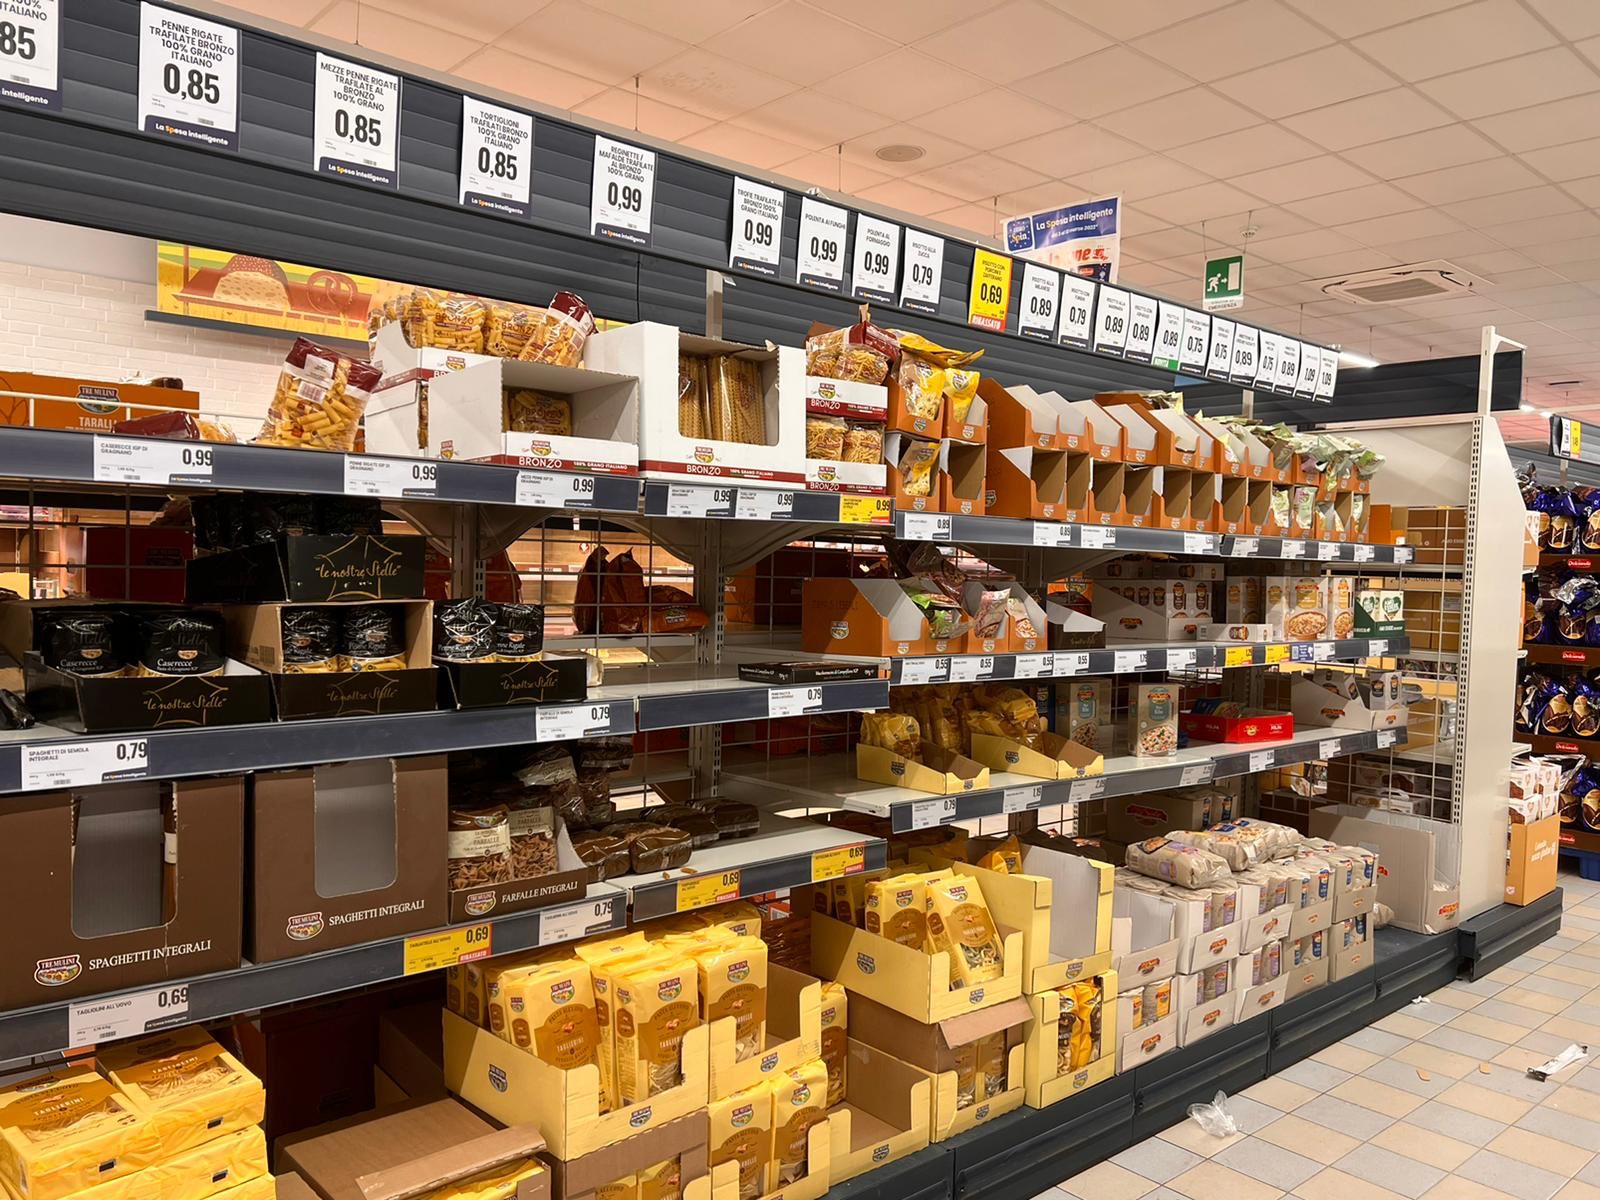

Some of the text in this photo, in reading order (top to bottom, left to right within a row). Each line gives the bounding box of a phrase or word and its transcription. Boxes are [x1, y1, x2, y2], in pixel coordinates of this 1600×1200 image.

[161, 19, 223, 43] PENNE RIGATE
[149, 26, 235, 56] TRAFILATE BRONZO
[161, 38, 223, 62] 100% GRANO
[171, 51, 213, 68] ITALIANO
[163, 63, 220, 104] 0,85
[320, 62, 397, 91] MEZZE PENNE RIGATE
[335, 74, 384, 95] TRAFILATE AL
[2, 88, 49, 104] intelligente
[333, 90, 384, 112] 100% GRANO
[343, 85, 375, 101] BRONZO
[470, 115, 528, 140] TRAFILATI BRONZO
[479, 110, 520, 128] TORTIGLIONI
[155, 123, 229, 145] La Spesa intelligente
[335, 109, 382, 147] 0,85
[477, 126, 520, 145] 100% GRANO
[484, 136, 513, 151] ITALIANO
[599, 150, 653, 171] MAFALDE TRAFILATE
[610, 145, 640, 161] REGINETTE
[478, 147, 517, 180] 0,85
[611, 160, 642, 175] AL BRONZO
[607, 166, 645, 183] 100% GRANO
[607, 181, 642, 213] 0,99
[743, 198, 762, 208] BRONZO
[740, 204, 779, 221] GRANO ITALIANO
[1036, 222, 1045, 231] La
[1045, 216, 1068, 230] Spesa
[1068, 207, 1114, 223] intelligente
[744, 219, 773, 246] 0,99
[810, 236, 838, 263] 0,99
[864, 250, 889, 275] 0,99
[912, 263, 933, 286] 0,79
[980, 283, 1003, 305] 0,69
[1030, 296, 1052, 317] 0,89
[435, 312, 474, 325] BRONZO
[1069, 306, 1087, 326] 0,79
[1104, 315, 1124, 334] 0,89
[1132, 322, 1150, 342] 0,89
[1162, 329, 1179, 347] 0,89
[1187, 335, 1203, 354] 0,75
[1214, 342, 1228, 360] 0,75
[1234, 349, 1253, 366] 0,89
[1281, 360, 1296, 377] 0,89
[811, 399, 841, 410] BRONZO
[182, 448, 214, 467] 0,99
[518, 456, 562, 469] BRONZO
[412, 464, 437, 481] 0,99
[686, 464, 721, 475] BRONZO
[573, 478, 594, 493] 0,99
[810, 481, 840, 492] BRONZO
[713, 489, 731, 502] 0,99
[777, 493, 793, 506] 0,99
[876, 499, 890, 511] 0,99
[937, 518, 950, 529] 0,89
[156, 657, 193, 667] Caserecce
[935, 658, 948, 670] 0,55
[980, 656, 992, 669] 0,55
[1042, 654, 1053, 666] 0,55
[1077, 655, 1088, 665] 0,55
[808, 688, 822, 700] 0,79
[591, 706, 610, 720] 0,79
[29, 748, 60, 757] SPAGHETTI
[29, 755, 59, 763] INTEGRALE
[116, 741, 148, 762] 0,79
[944, 799, 956, 811] 0,79
[849, 846, 864, 858] 0,69
[722, 871, 739, 886] 0,69
[501, 881, 578, 904] FARFALLE INTEGRALI
[328, 899, 425, 927] SPAGHETTI INTEGRALI
[594, 901, 613, 917] 0,79
[466, 926, 488, 944] 0,69
[41, 957, 76, 969] TRE MULINI
[88, 939, 212, 971] SPAGHETTI INTEGRALI
[460, 950, 487, 961] RIBASSATO
[158, 986, 189, 1008] 0,69
[76, 1005, 105, 1016] TAGLIOLINI
